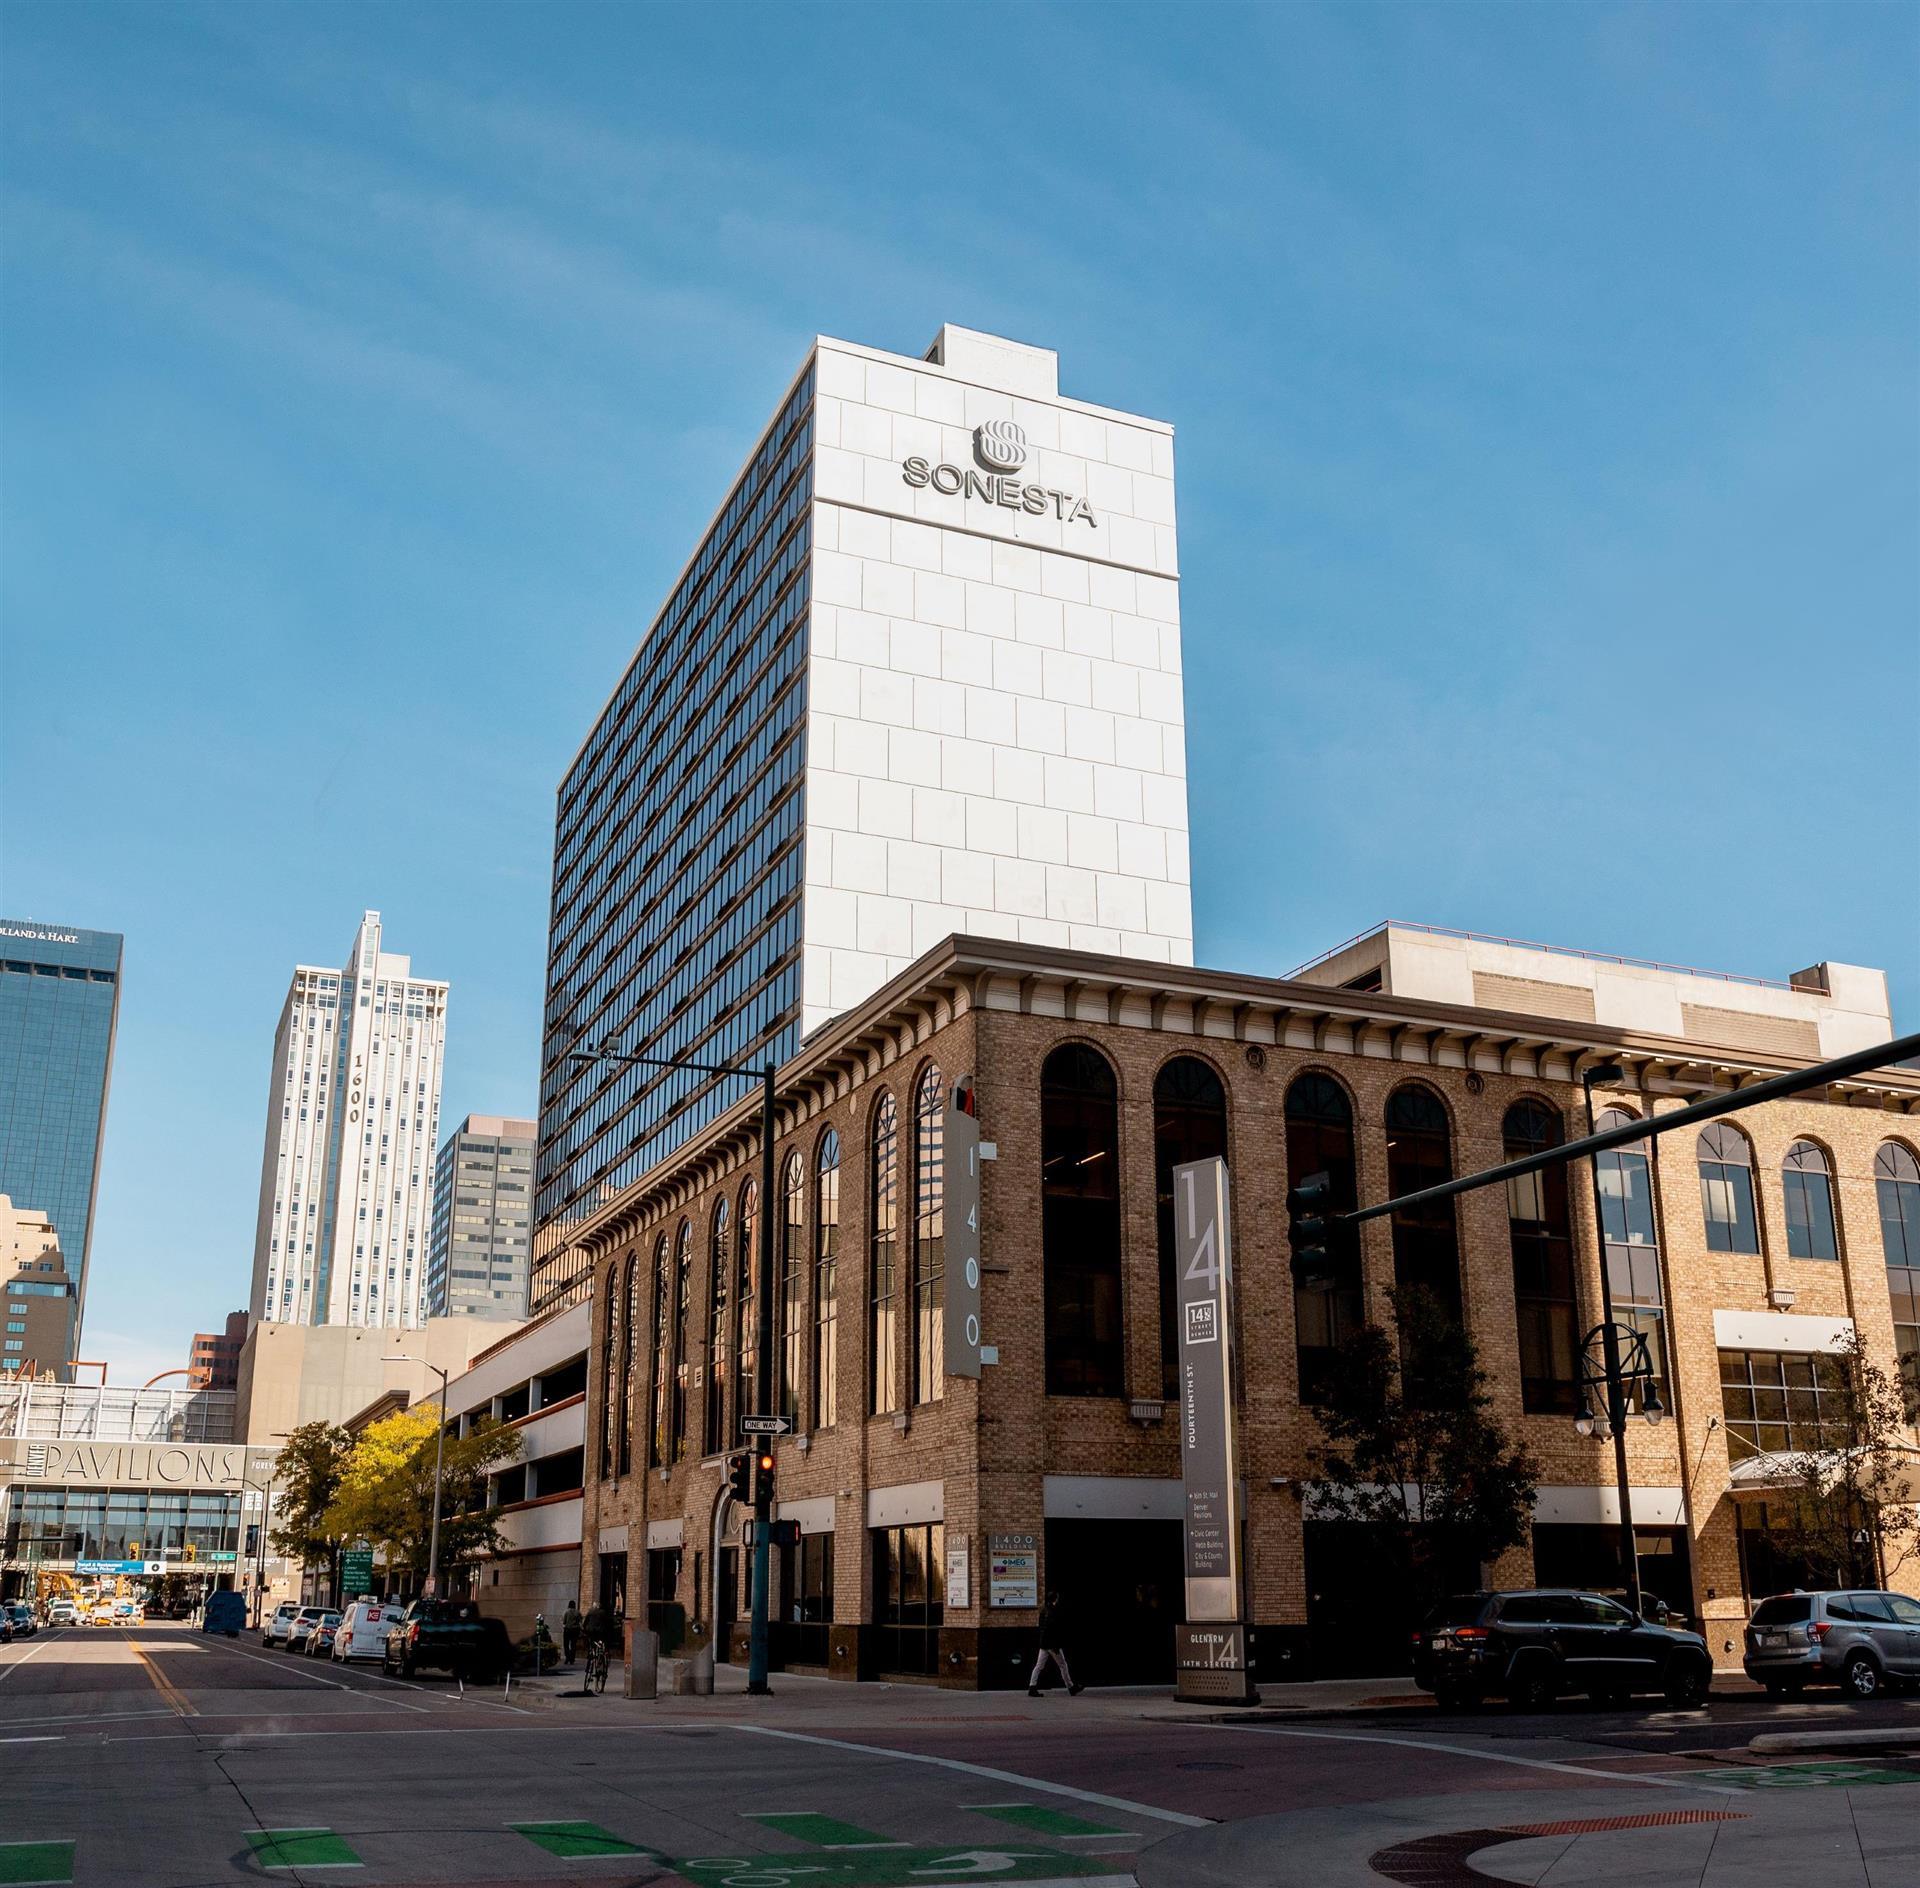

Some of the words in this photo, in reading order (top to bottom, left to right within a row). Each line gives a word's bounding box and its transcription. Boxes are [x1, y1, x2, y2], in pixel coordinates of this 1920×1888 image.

[902, 456, 1098, 528] SONESTA
[38, 932, 46, 940] &
[350, 1054, 362, 1123] 1600
[966, 1146, 979, 1347] 1400
[1181, 1170, 1220, 1291] 14
[1186, 1362, 1194, 1378] ST.
[746, 1421, 761, 1429] ONE
[762, 1421, 777, 1429] WAY
[1186, 1380, 1196, 1449] FOURTEENTH
[26, 1444, 46, 1477] DENVER
[45, 1445, 234, 1483] PAVILIONS
[252, 1461, 280, 1470] FOREV
[1190, 1634, 1223, 1643] GLENARM
[1206, 1632, 1238, 1669] 14
[1204, 1660, 1235, 1668] STREET
